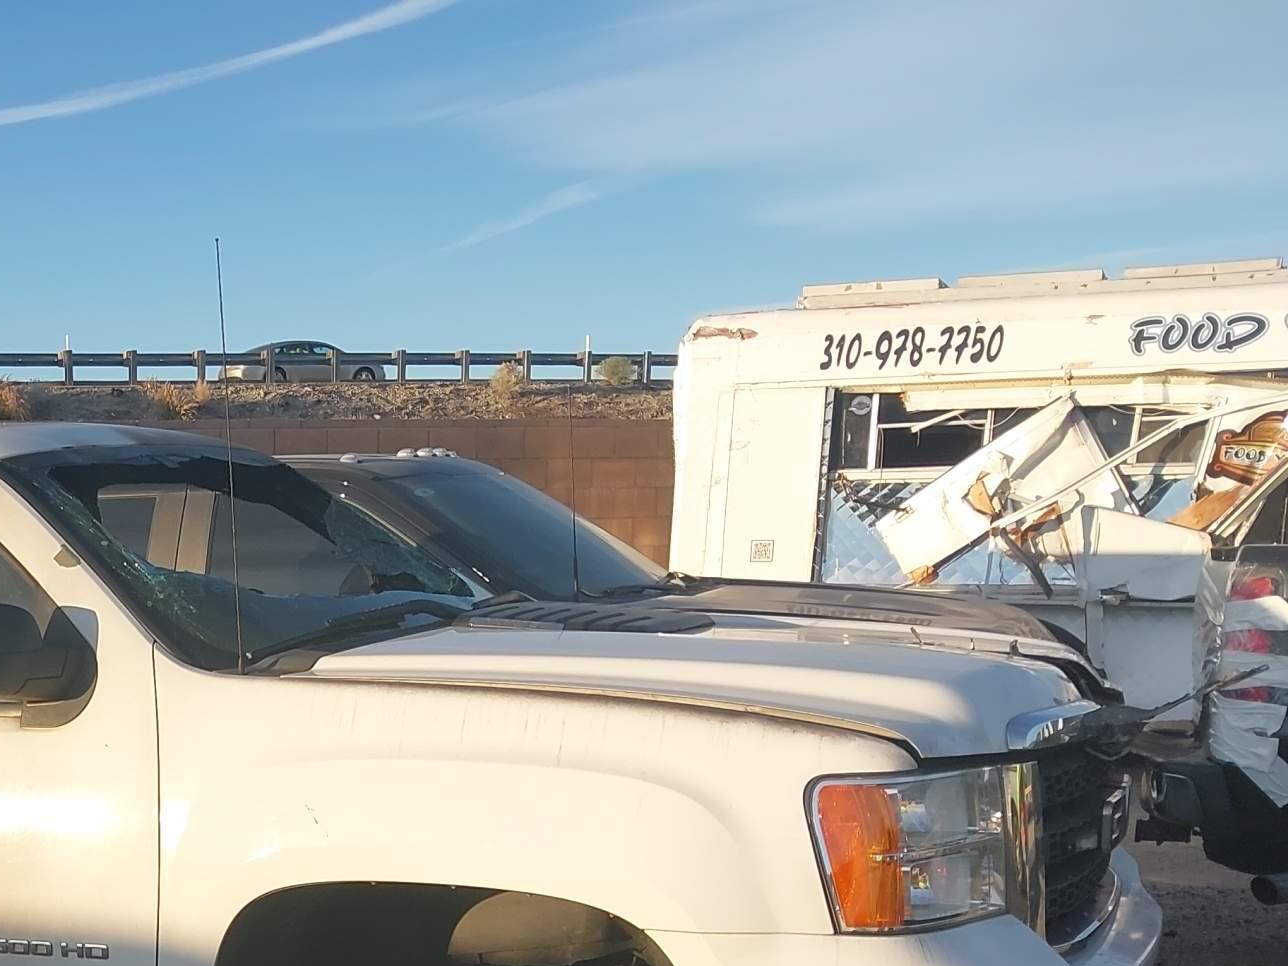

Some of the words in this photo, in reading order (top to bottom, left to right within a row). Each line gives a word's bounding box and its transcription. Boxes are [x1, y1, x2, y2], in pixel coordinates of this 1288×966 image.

[819, 324, 1004, 371] 310-978-7750
[1129, 312, 1269, 356] FOOD
[60, 942, 110, 960] HD
